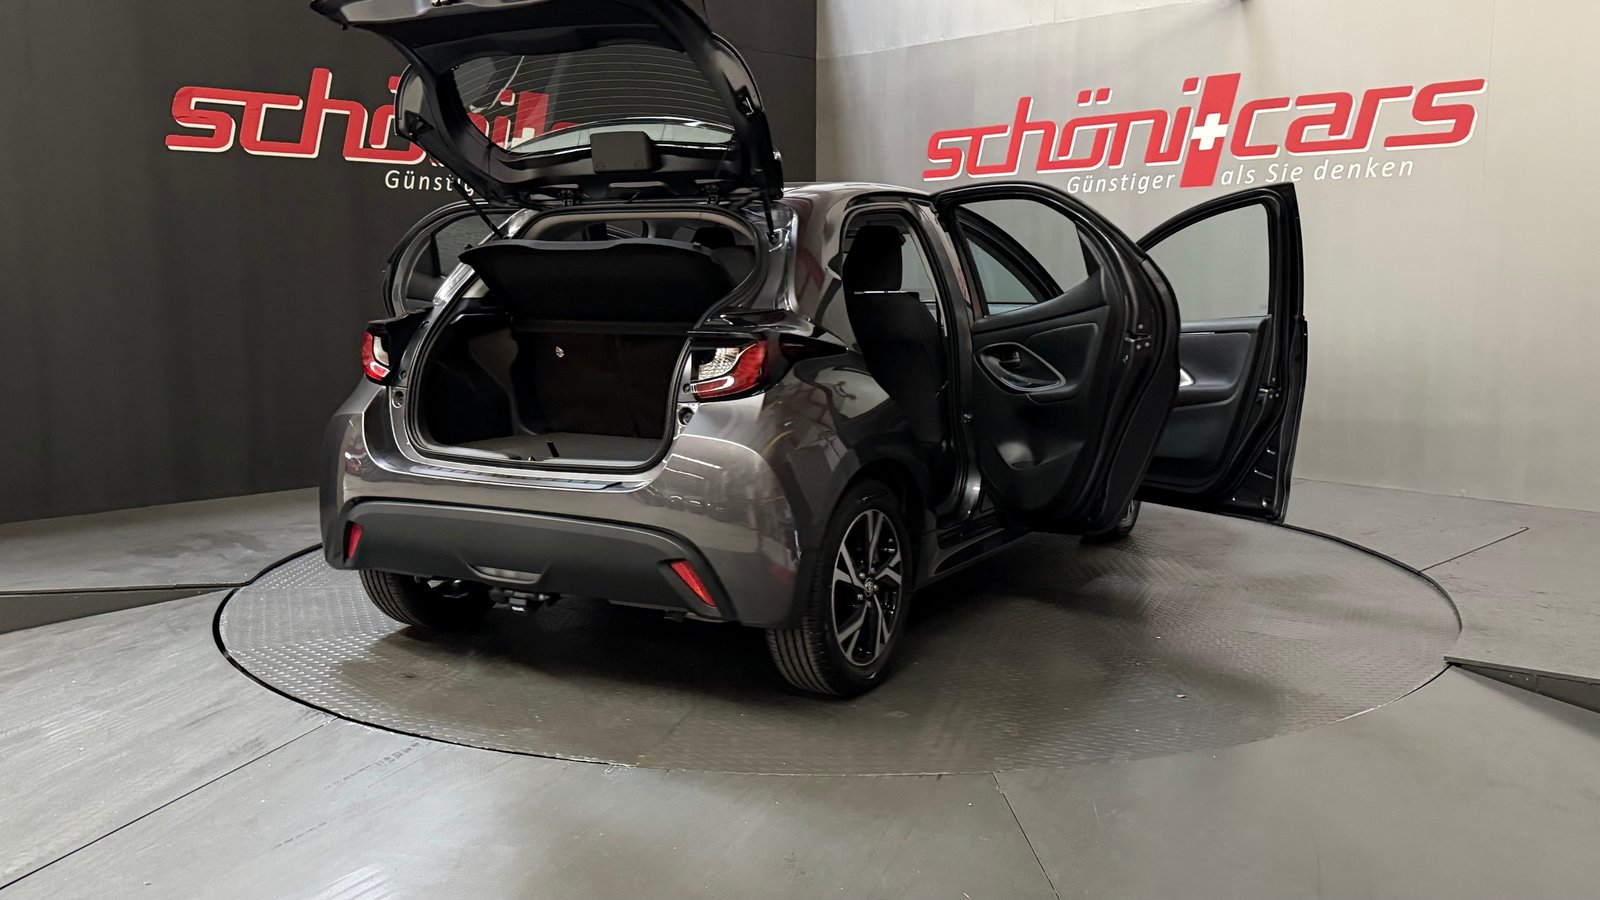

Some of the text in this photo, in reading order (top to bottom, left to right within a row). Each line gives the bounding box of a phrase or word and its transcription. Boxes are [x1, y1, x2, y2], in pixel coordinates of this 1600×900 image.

[1230, 78, 1486, 160] cars
[1066, 156, 1415, 195] Günstiger als Sie denken
